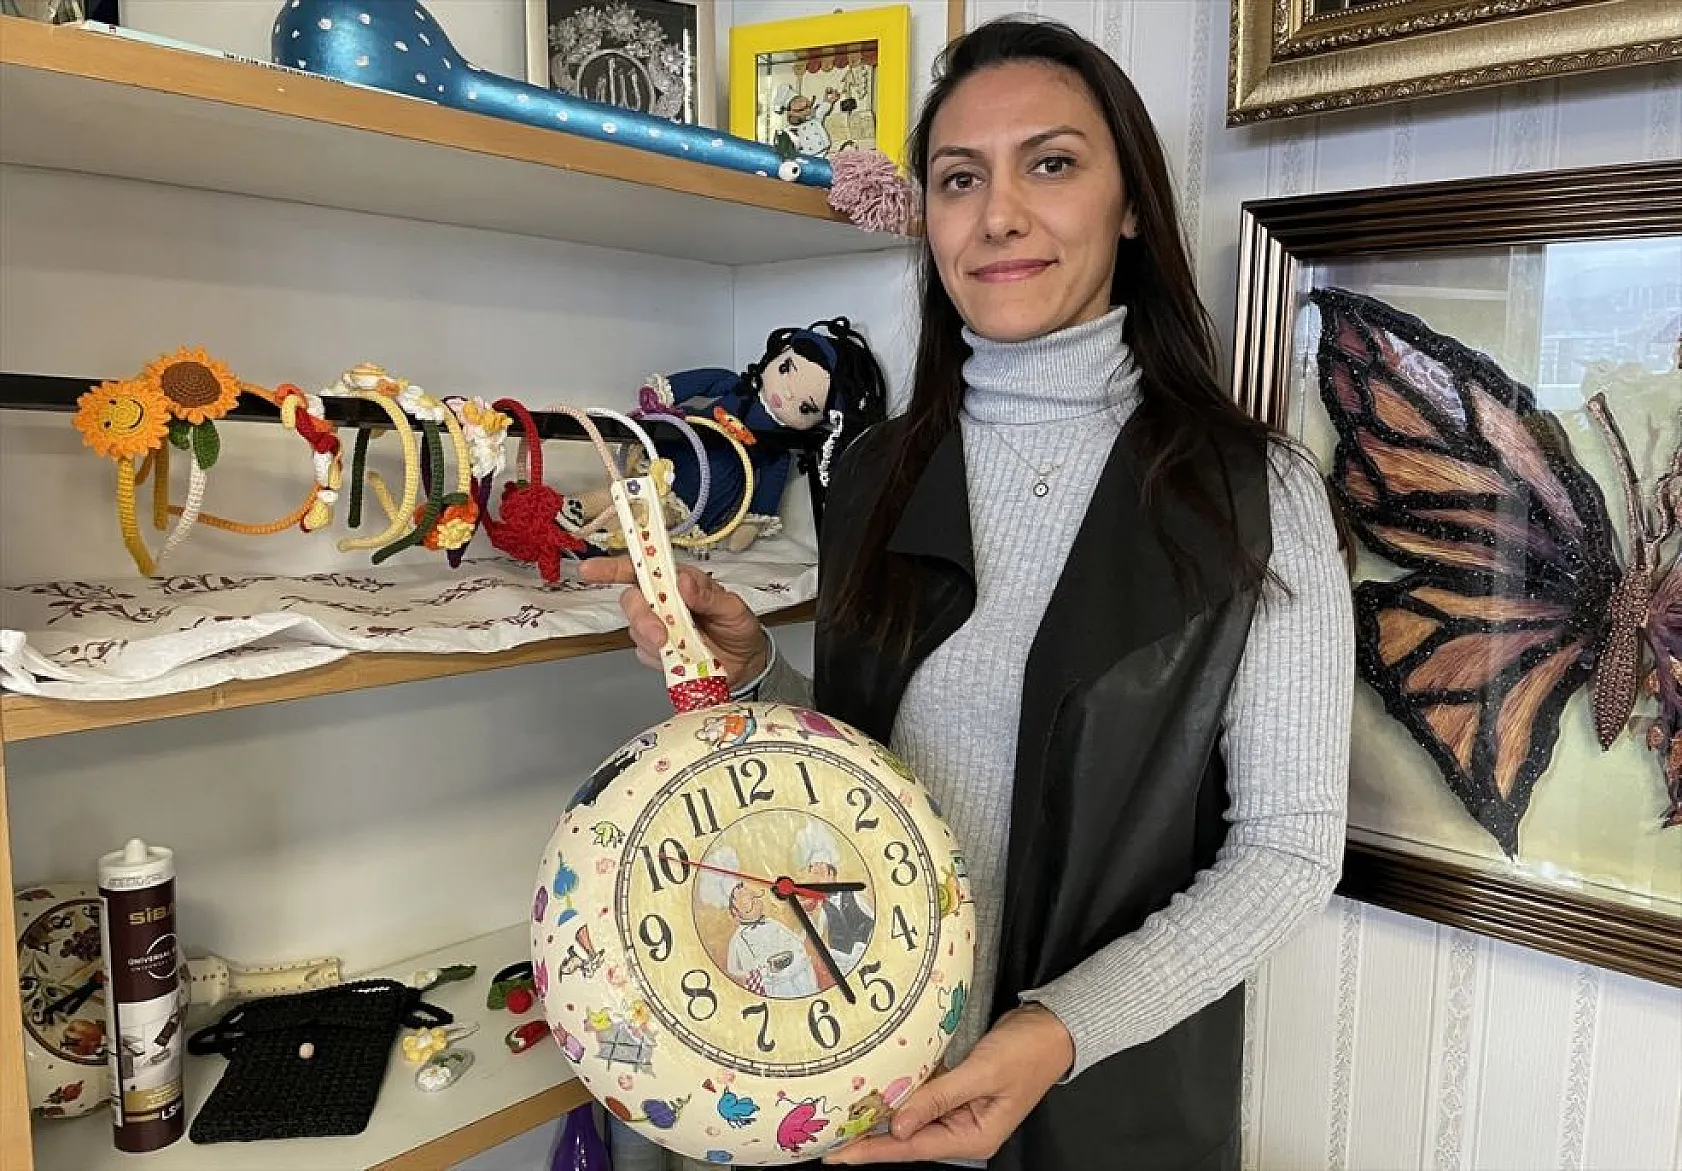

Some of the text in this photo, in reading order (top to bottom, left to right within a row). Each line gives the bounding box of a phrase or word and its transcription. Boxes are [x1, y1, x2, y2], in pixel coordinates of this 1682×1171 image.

[725, 758, 775, 809] 12
[795, 761, 820, 805] 1
[681, 787, 721, 838] 11
[846, 786, 880, 833] 2
[640, 837, 692, 893] 10
[883, 840, 918, 886] 3
[638, 913, 673, 962] 9
[890, 904, 918, 951] 4
[680, 969, 718, 1021] 8
[858, 960, 896, 1013] 5
[741, 1001, 776, 1052] 7
[807, 999, 842, 1049] 6
